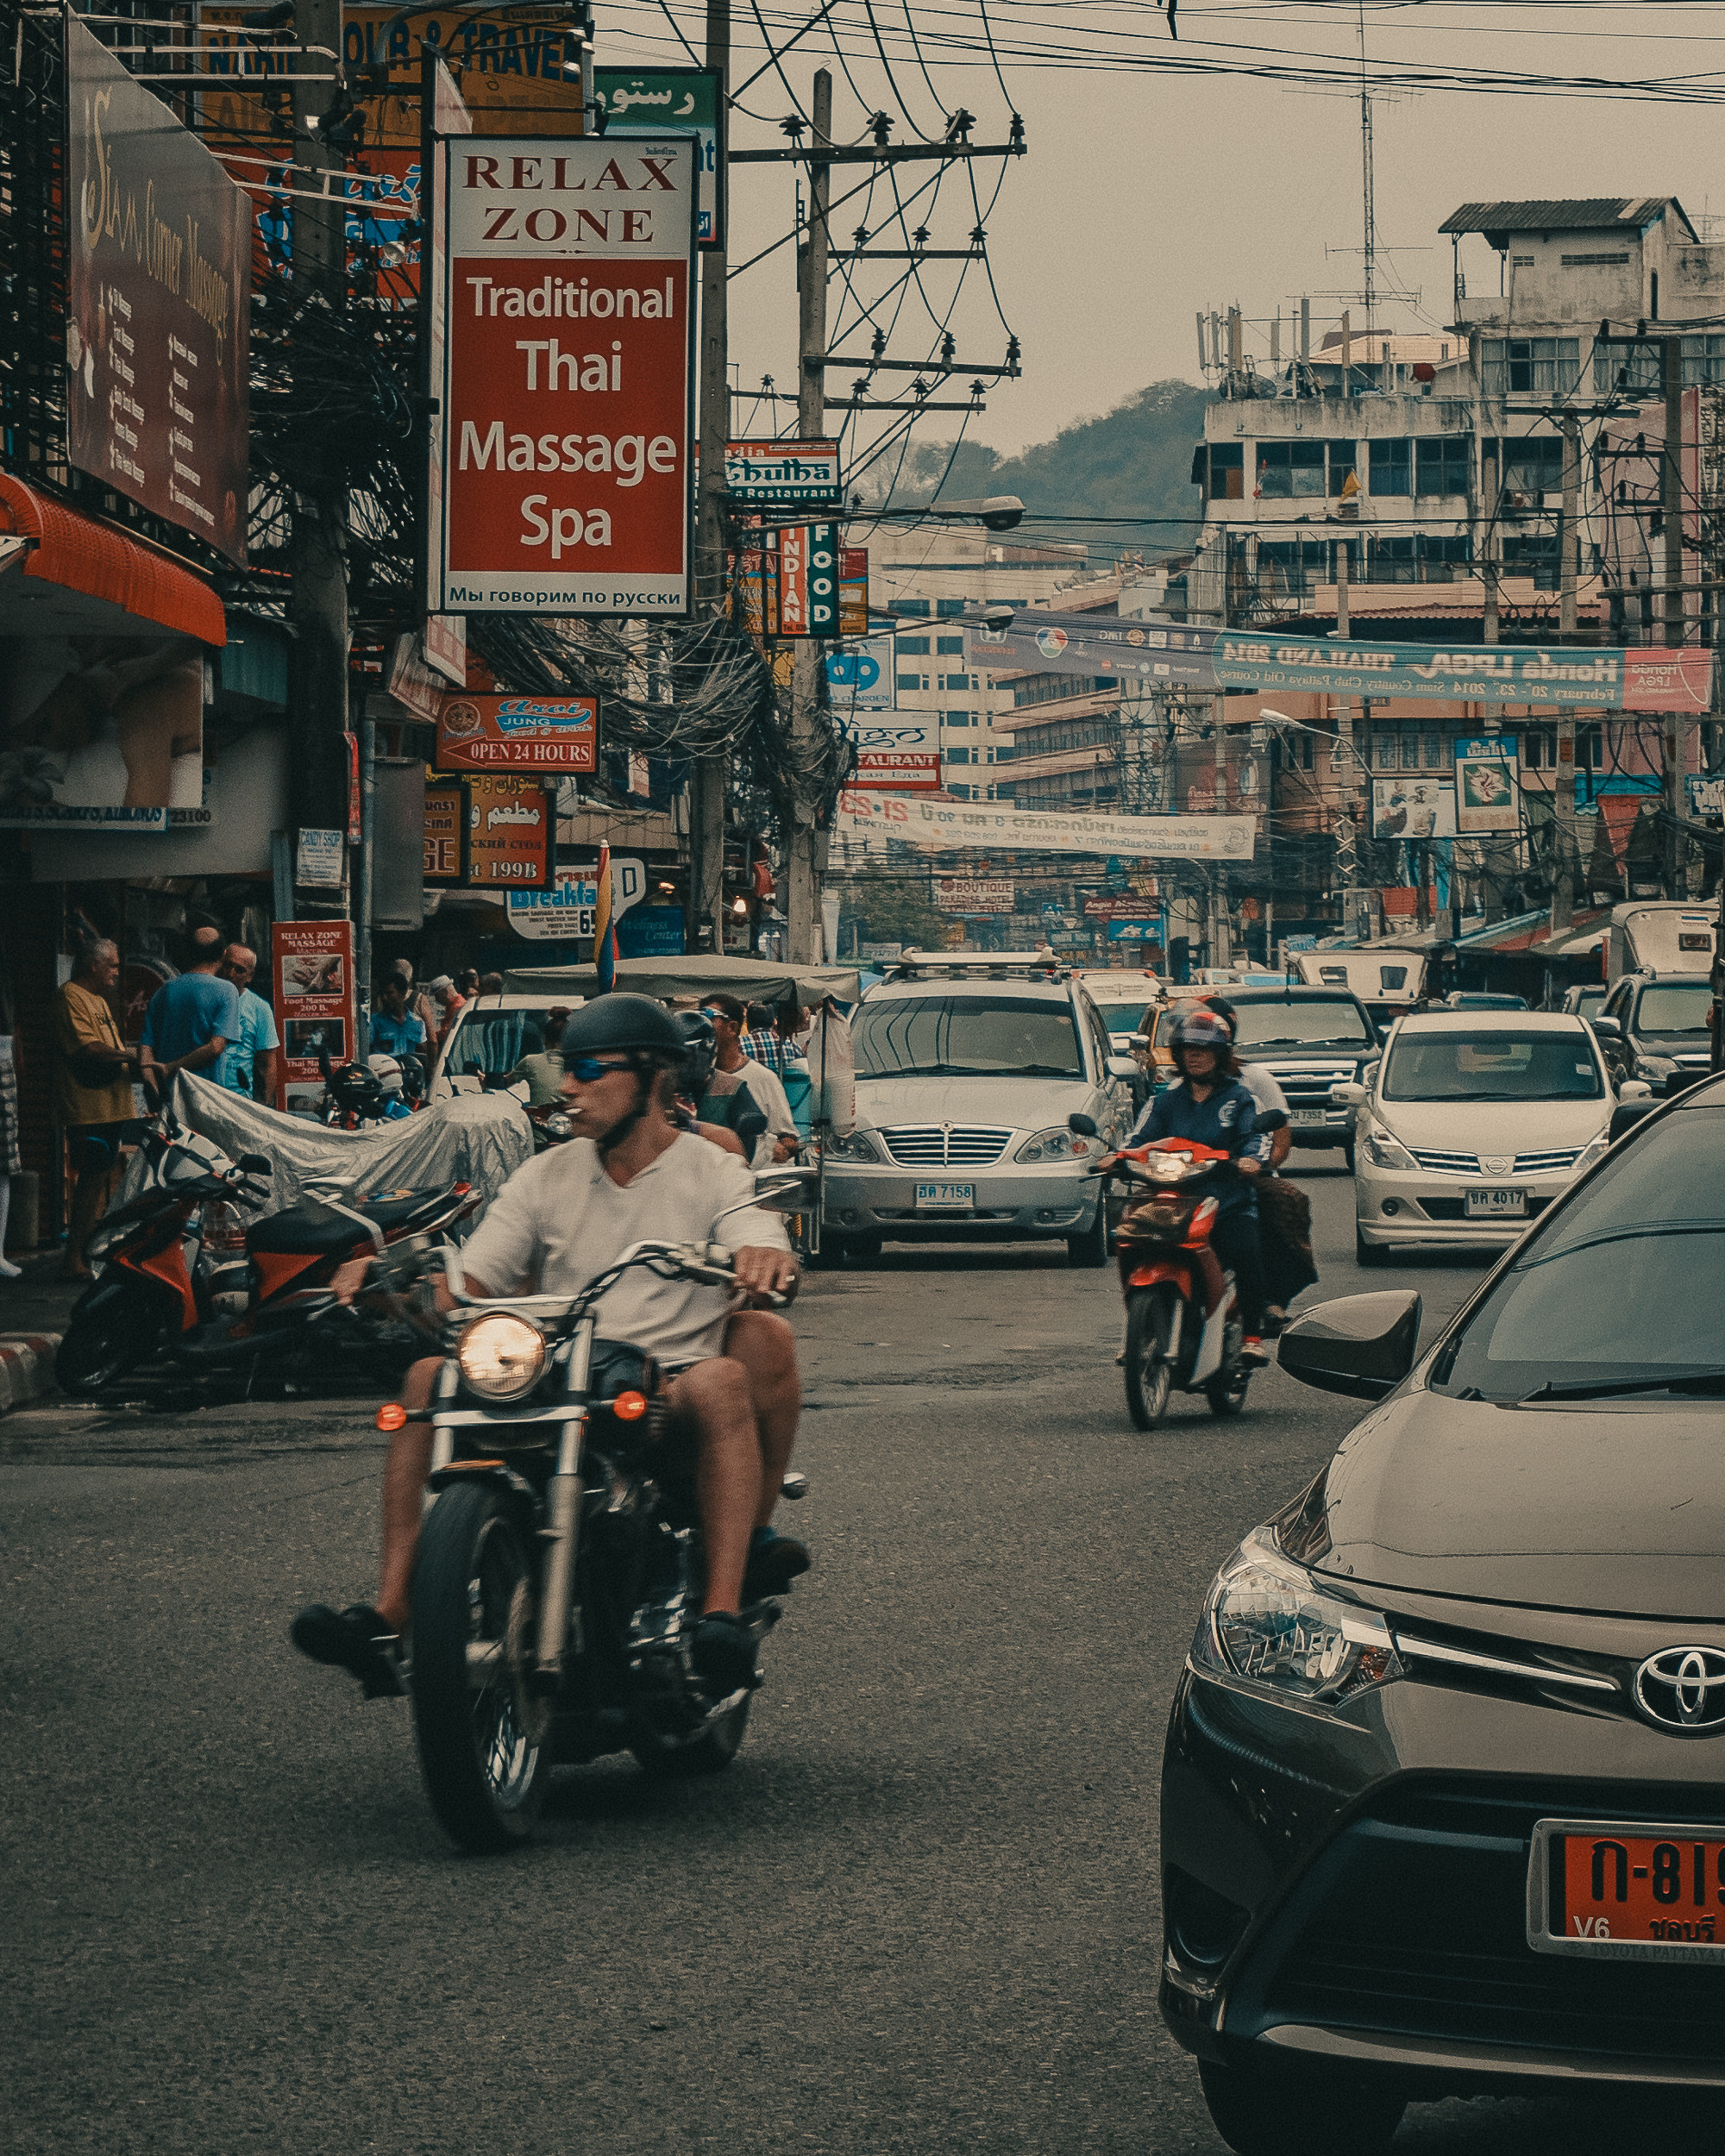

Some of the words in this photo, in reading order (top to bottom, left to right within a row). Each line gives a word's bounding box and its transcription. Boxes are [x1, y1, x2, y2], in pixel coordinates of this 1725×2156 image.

[343, 21, 411, 71] OUR
[461, 155, 679, 191] RELAX
[480, 207, 655, 243] ZONE
[466, 276, 674, 318] Traditional
[516, 338, 622, 392] Thai
[458, 420, 677, 487] Massage
[724, 446, 766, 457] ndia
[747, 488, 835, 498] Restaurant
[519, 494, 612, 560] Spa
[783, 528, 801, 623] INDIAN
[812, 524, 833, 622] FOOD
[449, 587, 483, 603] Мы
[489, 591, 576, 605] говорим
[582, 592, 606, 604] по
[612, 592, 681, 607] русски
[503, 718, 551, 726] JUNG
[471, 743, 510, 760] OPEN
[514, 745, 530, 761] 24
[534, 745, 590, 761] HOURS
[857, 755, 937, 767] TAURANT
[487, 799, 541, 830] مطعم
[511, 881, 597, 908] Breakfa
[956, 882, 1013, 893] BOUTIQUE
[280, 931, 314, 941] RELAX
[317, 931, 343, 939] ZONE
[287, 939, 336, 948] MASSAGE
[645, 931, 682, 942] Center
[306, 996, 344, 1006] Massage
[1302, 1111, 1322, 1119] 7352
[941, 1185, 970, 1198] 7158
[1493, 1191, 1522, 1205] 4017
[1572, 1915, 1611, 1939] V6
[1591, 1943, 1649, 1959] TOYOTA
[1653, 1945, 1715, 1962] PATTAYA
